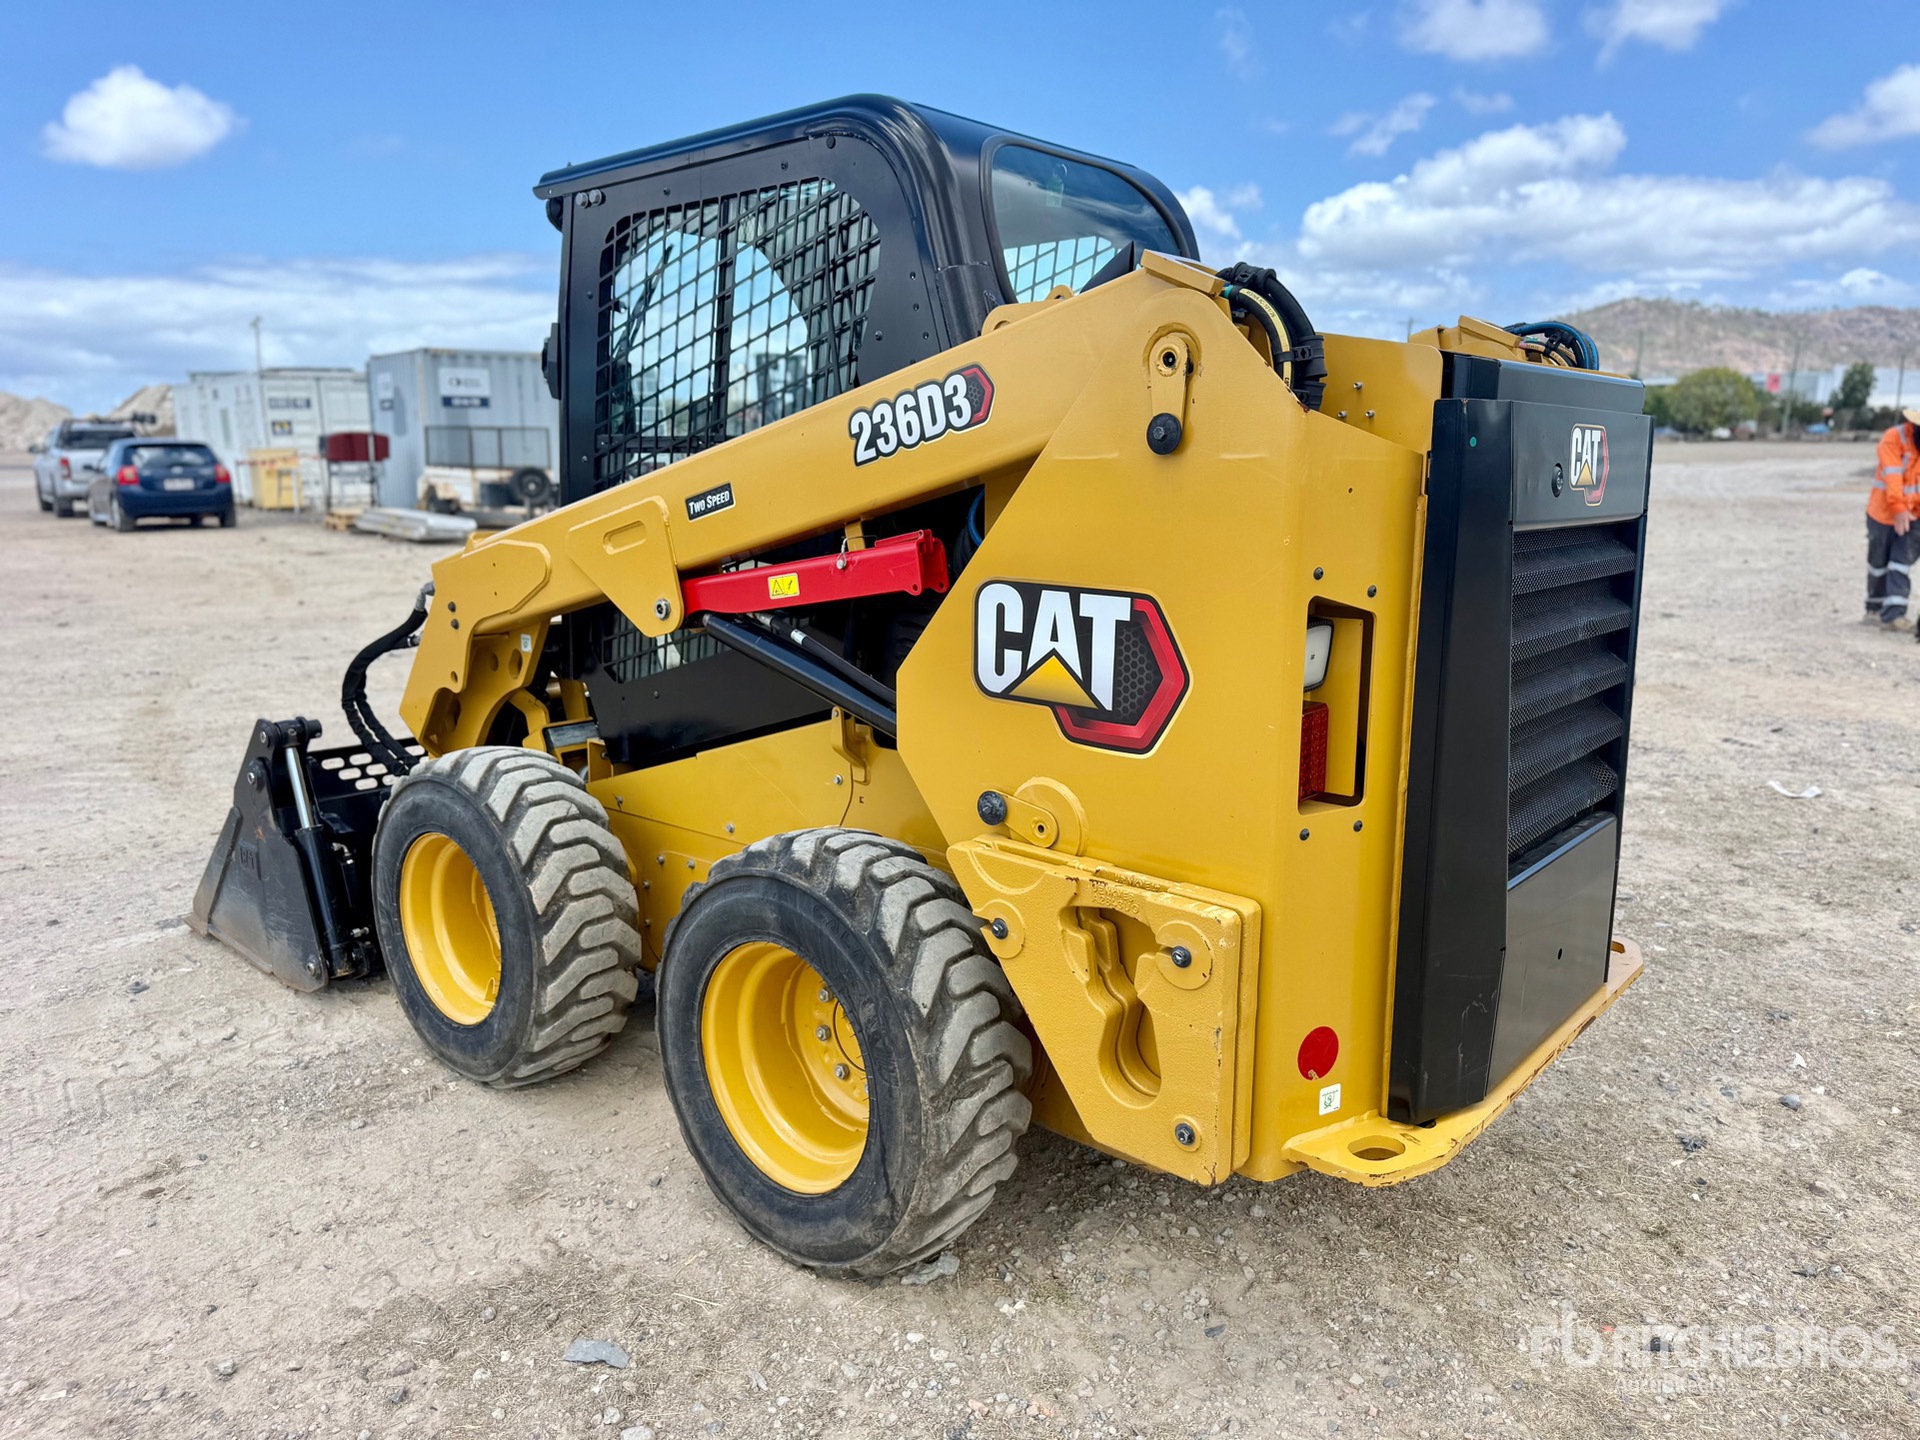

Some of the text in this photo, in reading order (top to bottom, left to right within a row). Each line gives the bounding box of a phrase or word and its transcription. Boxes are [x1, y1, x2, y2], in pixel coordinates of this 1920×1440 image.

[850, 373, 972, 463] 236D3
[1570, 427, 1601, 486] CAT
[977, 582, 1132, 712] CAT
